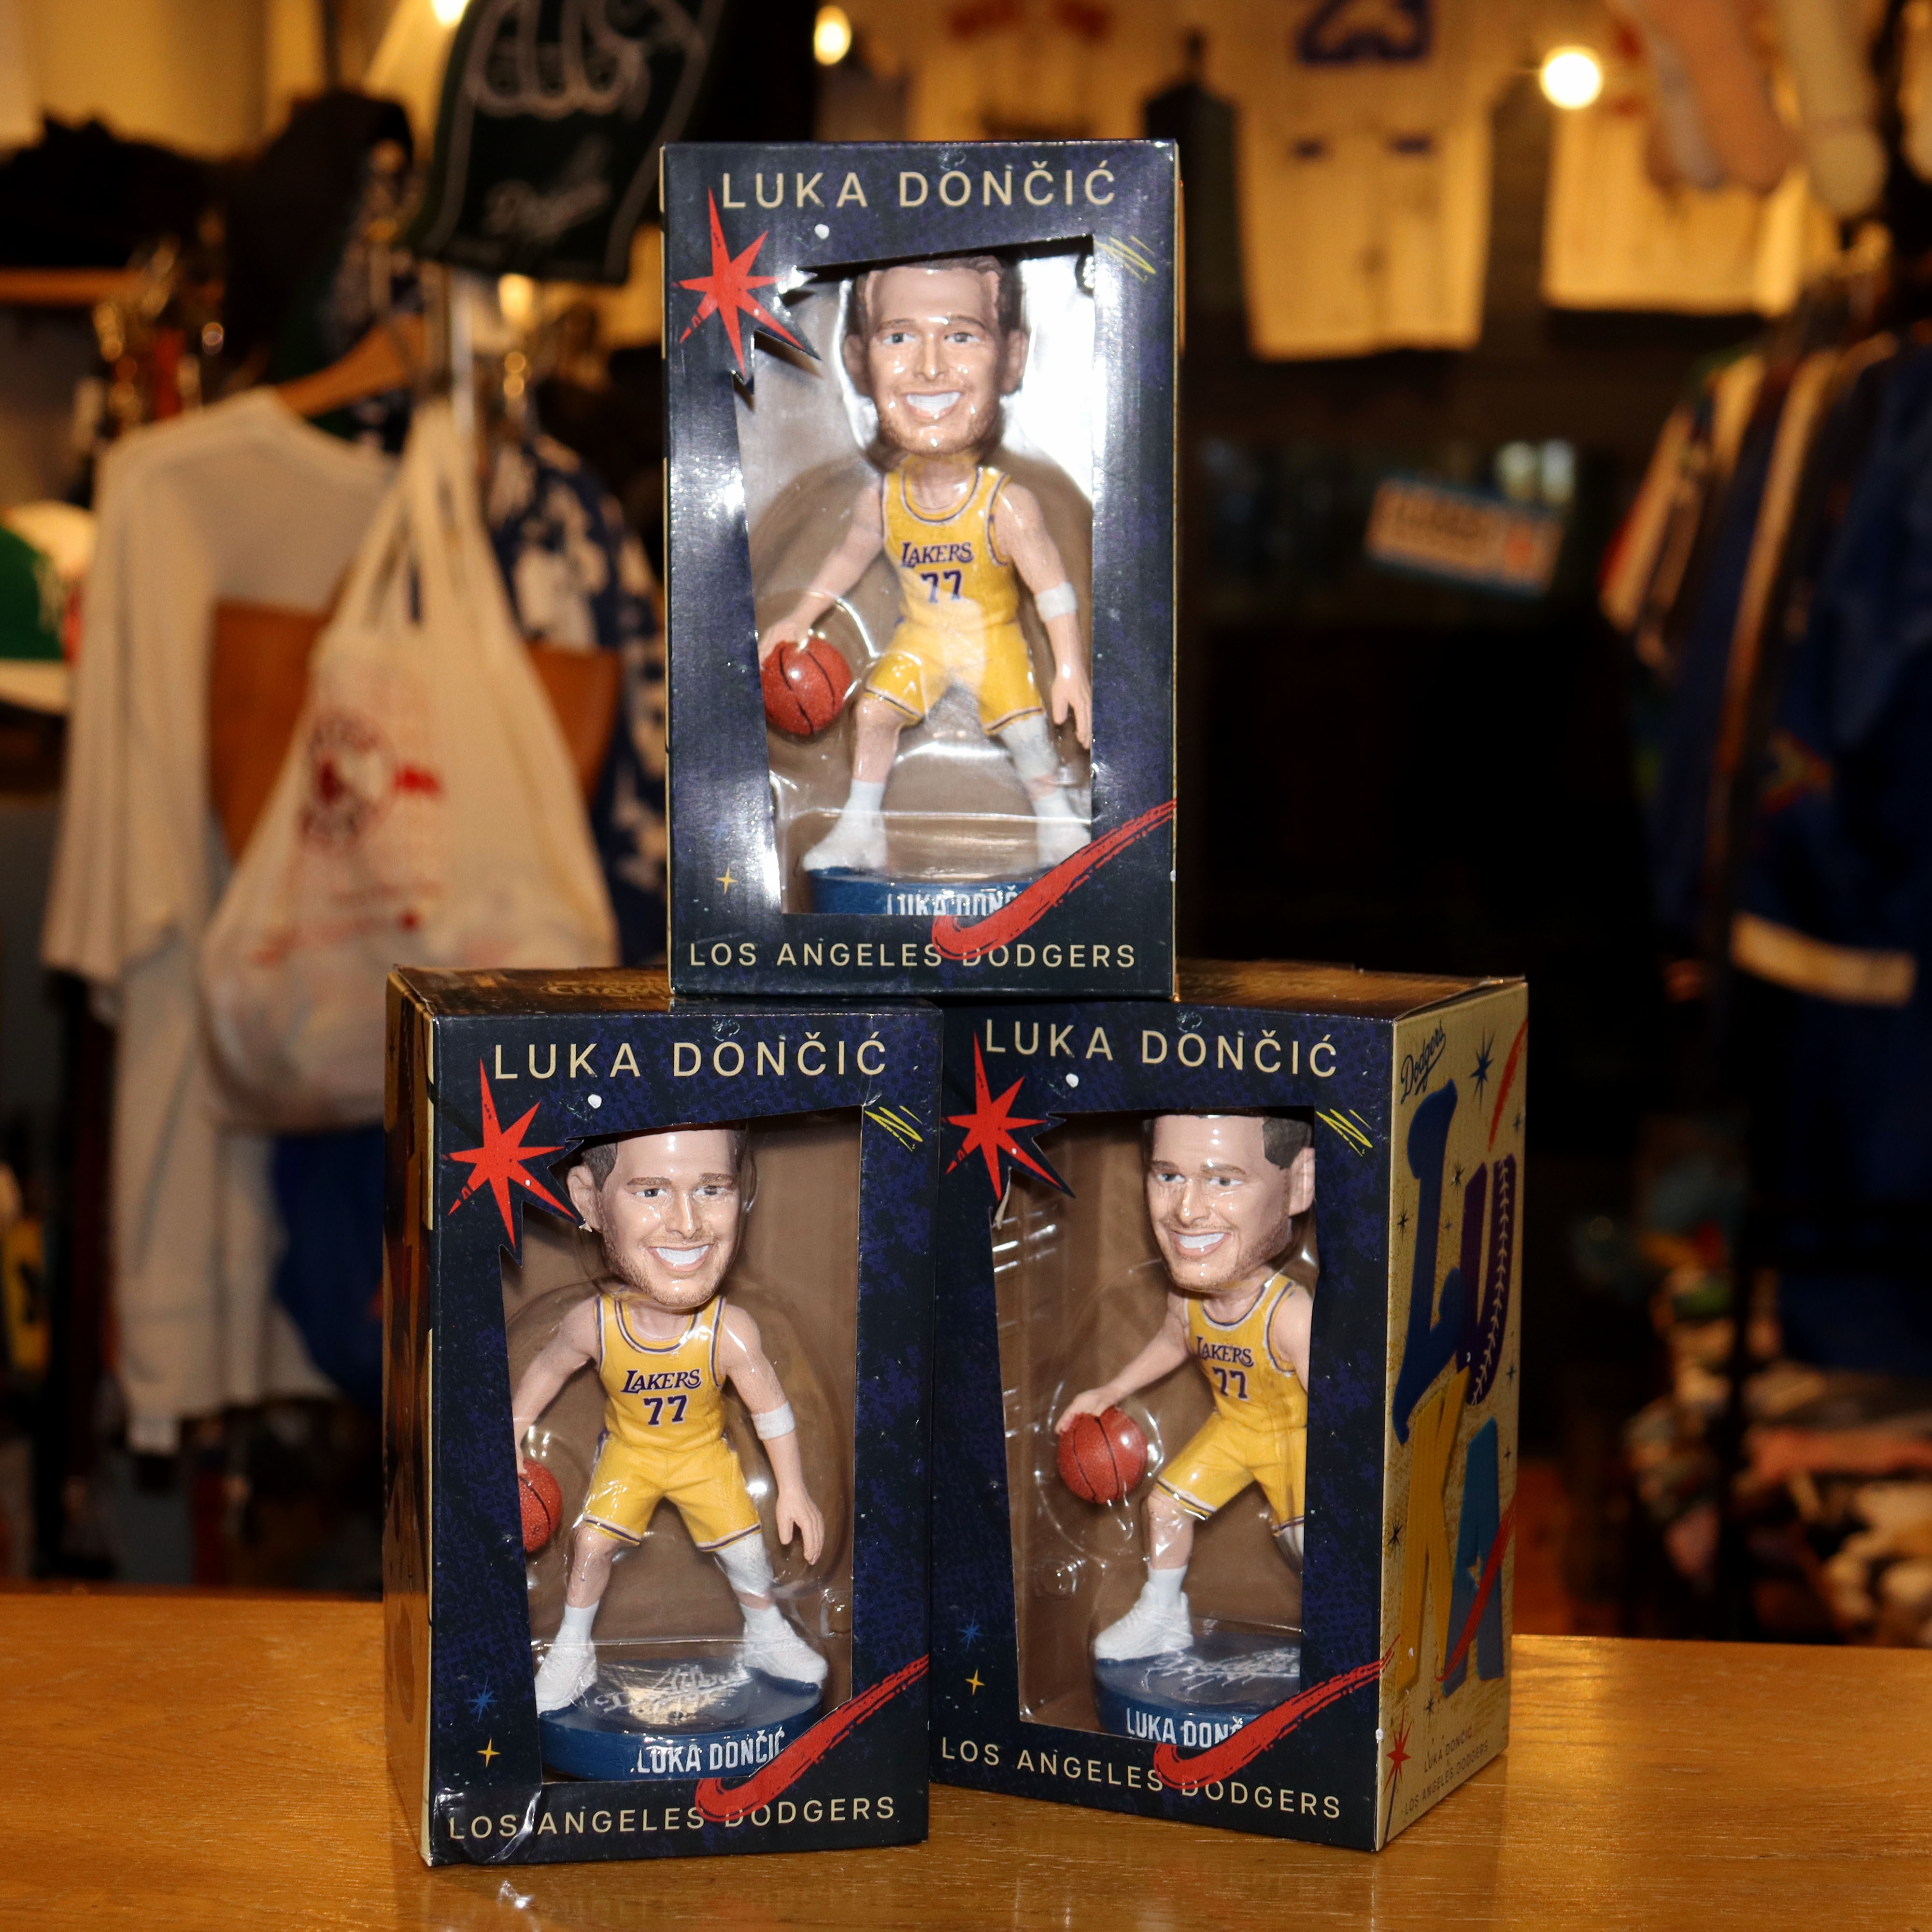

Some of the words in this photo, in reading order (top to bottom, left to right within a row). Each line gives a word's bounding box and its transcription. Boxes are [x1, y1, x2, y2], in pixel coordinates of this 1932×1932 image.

[723, 173, 867, 208] LUKA
[899, 161, 1114, 207] DONČIĆ
[901, 541, 974, 568] LAKERS
[920, 570, 962, 603] 77
[690, 943, 756, 966] LOS
[777, 943, 942, 966] ANGELES
[495, 1043, 641, 1080] LUKA
[673, 1032, 886, 1077] DONČIĆ
[986, 1020, 1113, 1061] LUKA
[1142, 1030, 1336, 1078] DONČIĆ
[1401, 1019, 1446, 1105] Dodgers
[1196, 1336, 1254, 1367] LAKERS
[620, 1368, 702, 1394] LAKERS
[1212, 1366, 1248, 1398] 77
[643, 1394, 687, 1425] 77
[1126, 1707, 1177, 1745] LUKA
[637, 1744, 702, 1774] LUKA
[942, 1737, 999, 1766] LOS
[1017, 1750, 1163, 1791] ANGELES
[1424, 1749, 1443, 1773] LUKA
[1405, 1794, 1419, 1815] LOS
[1422, 1767, 1454, 1800] ANGELES
[1456, 1739, 1488, 1775] DODGERS
[449, 1816, 517, 1840] LOS
[537, 1807, 704, 1835] ANGELES
